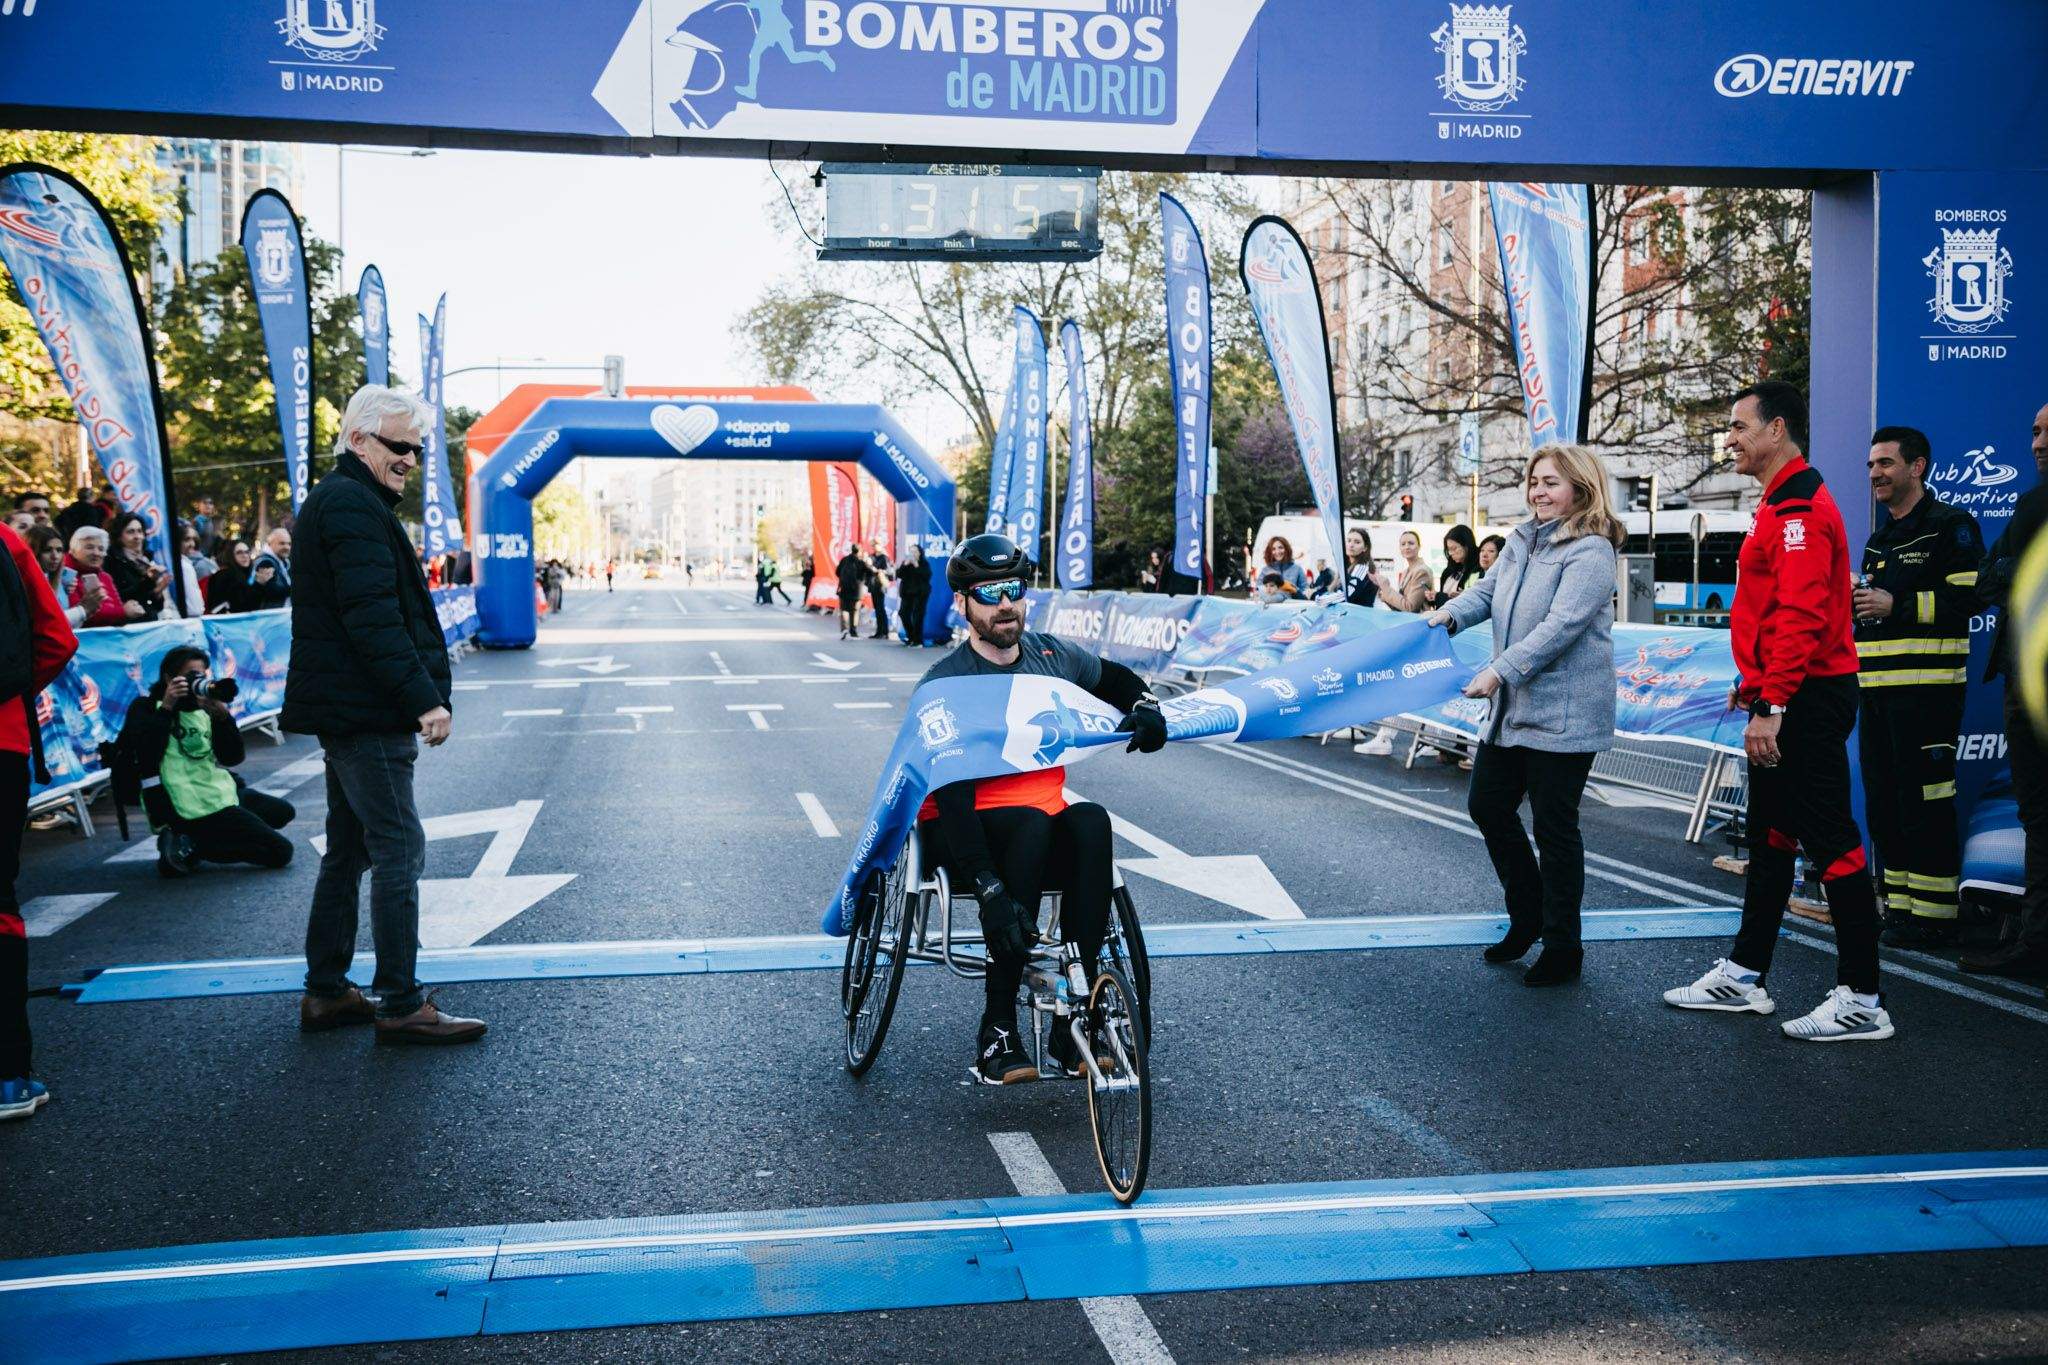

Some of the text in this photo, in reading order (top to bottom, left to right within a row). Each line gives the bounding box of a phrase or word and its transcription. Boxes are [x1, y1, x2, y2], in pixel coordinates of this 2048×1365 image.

[805, 1, 1165, 62] BOMBEROS
[306, 74, 384, 92] MADRID
[946, 58, 1166, 117] de MADRID
[1768, 59, 1914, 97] ENERVIT
[1458, 124, 1522, 139] MADRID
[1935, 209, 2007, 222] BOMBEROS
[868, 239, 1081, 249] hour min. sec.
[1948, 345, 2007, 359] MADRID
[514, 430, 560, 475] MADRID
[886, 445, 929, 488] MADRID
[1926, 462, 1959, 483] lub
[1366, 669, 1395, 682] MADRID
[857, 820, 879, 863] MADRID
